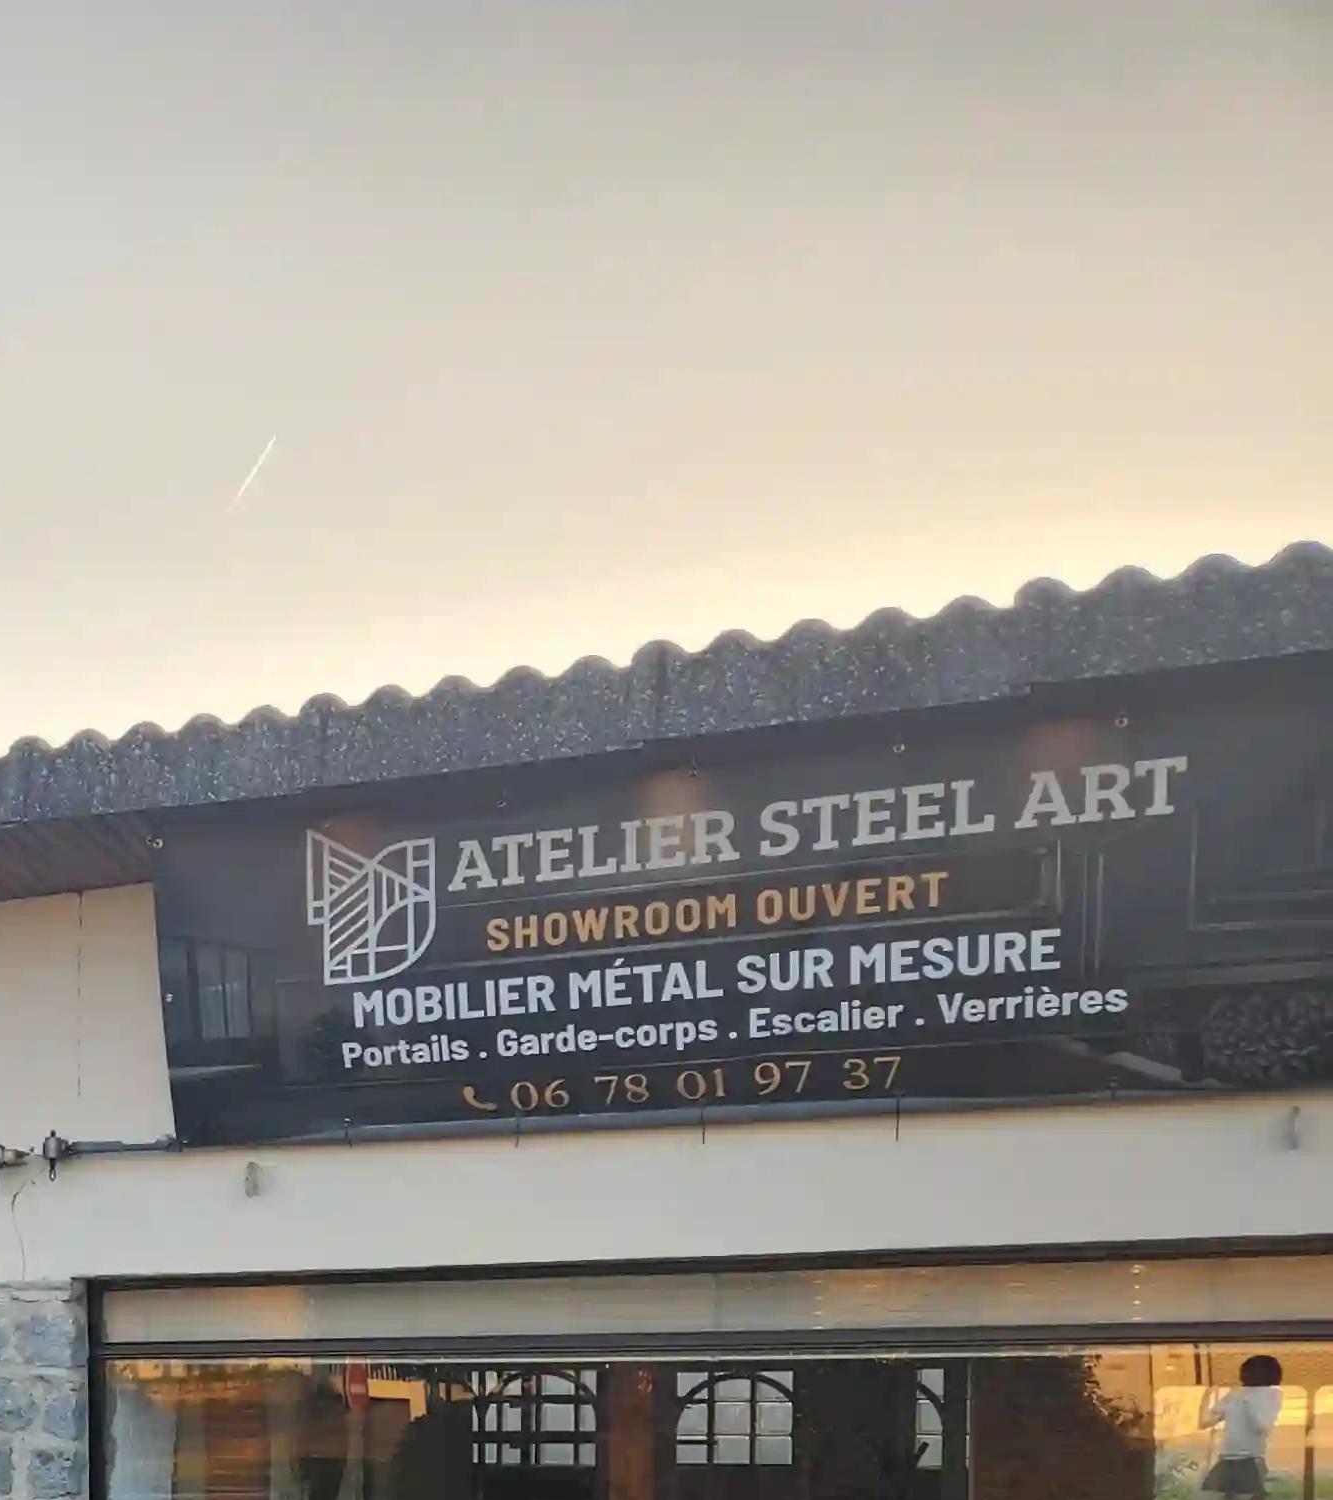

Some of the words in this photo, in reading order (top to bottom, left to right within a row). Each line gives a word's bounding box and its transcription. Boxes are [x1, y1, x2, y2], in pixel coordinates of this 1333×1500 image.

[447, 811, 741, 892] ATELIER
[759, 779, 995, 857] STEEL
[1014, 757, 1188, 828] ART
[486, 894, 737, 951] SHOWROOM
[757, 871, 949, 925] OUVERT
[353, 975, 556, 1028] MOBILIER
[568, 958, 724, 1010] MÉTAL
[737, 948, 834, 994] SUR
[850, 928, 1061, 985] MESURE
[341, 1034, 470, 1069] Portails
[496, 1019, 718, 1057] Garde-corps
[749, 1000, 904, 1038] Escalier
[936, 986, 1128, 1024] Verrières
[510, 1078, 569, 1109] 06
[593, 1073, 650, 1105] 78
[676, 1068, 726, 1100] 01
[754, 1060, 812, 1095] 97
[842, 1055, 902, 1090] 37
